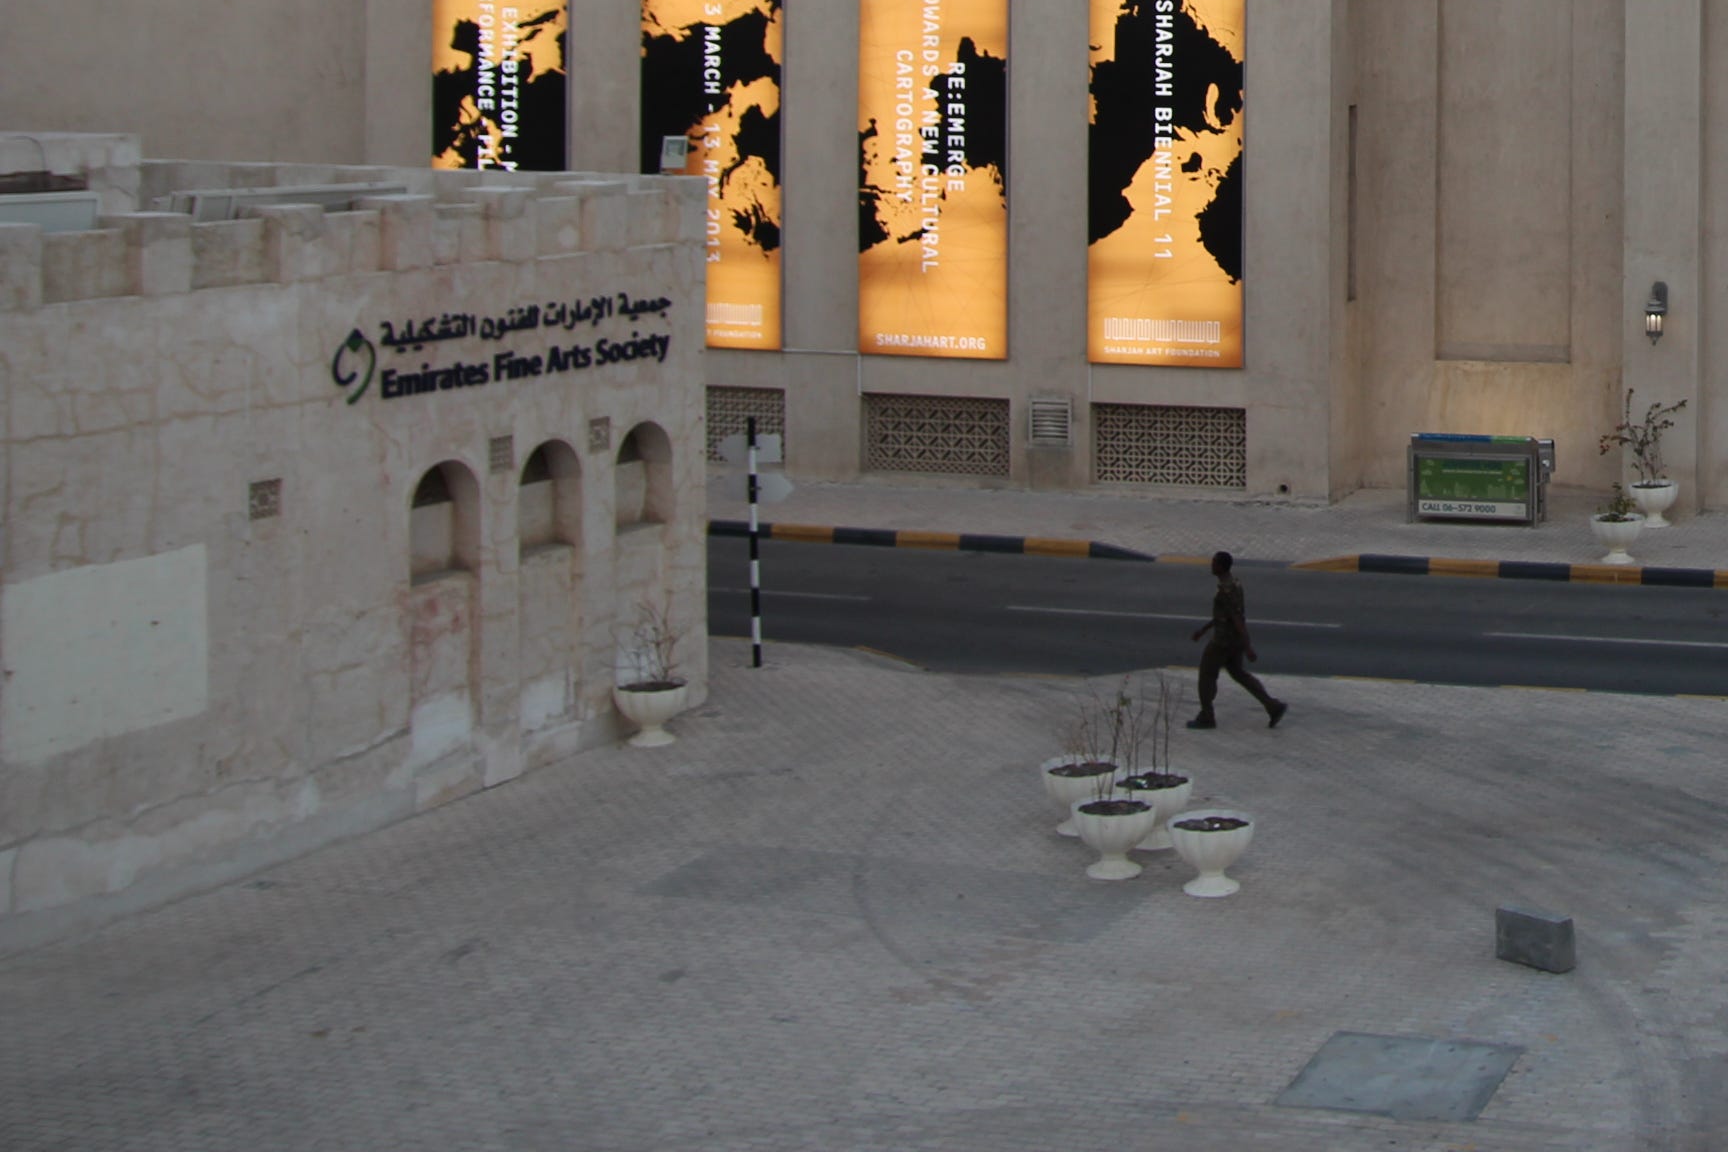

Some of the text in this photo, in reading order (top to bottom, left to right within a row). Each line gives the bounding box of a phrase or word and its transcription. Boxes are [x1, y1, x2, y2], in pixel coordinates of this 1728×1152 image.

[500, 7, 518, 138] EXHIBITION
[704, 26, 721, 95] MARCH
[921, 87, 940, 100] A
[704, 123, 721, 148] 13
[895, 50, 914, 203] CARTOGRAPHY
[921, 110, 939, 155] NEW
[947, 61, 966, 192] RE:EMERGE
[1154, 0, 1174, 260] SHARJAH BIENNIAL 11
[477, 135, 496, 172] FIL
[704, 159, 720, 199] MAY
[920, 163, 939, 273] CULTURAL
[480, 306, 540, 339] للفنون
[617, 293, 672, 319] جمعية
[380, 315, 477, 352] التشكيلية
[876, 333, 986, 350] SHARJAHART.ORG
[1103, 346, 1220, 358] SHARJAH ART FOUNDATION
[380, 331, 671, 400] Emirates Fine Arts Society
[1422, 502, 1440, 511] CALL
